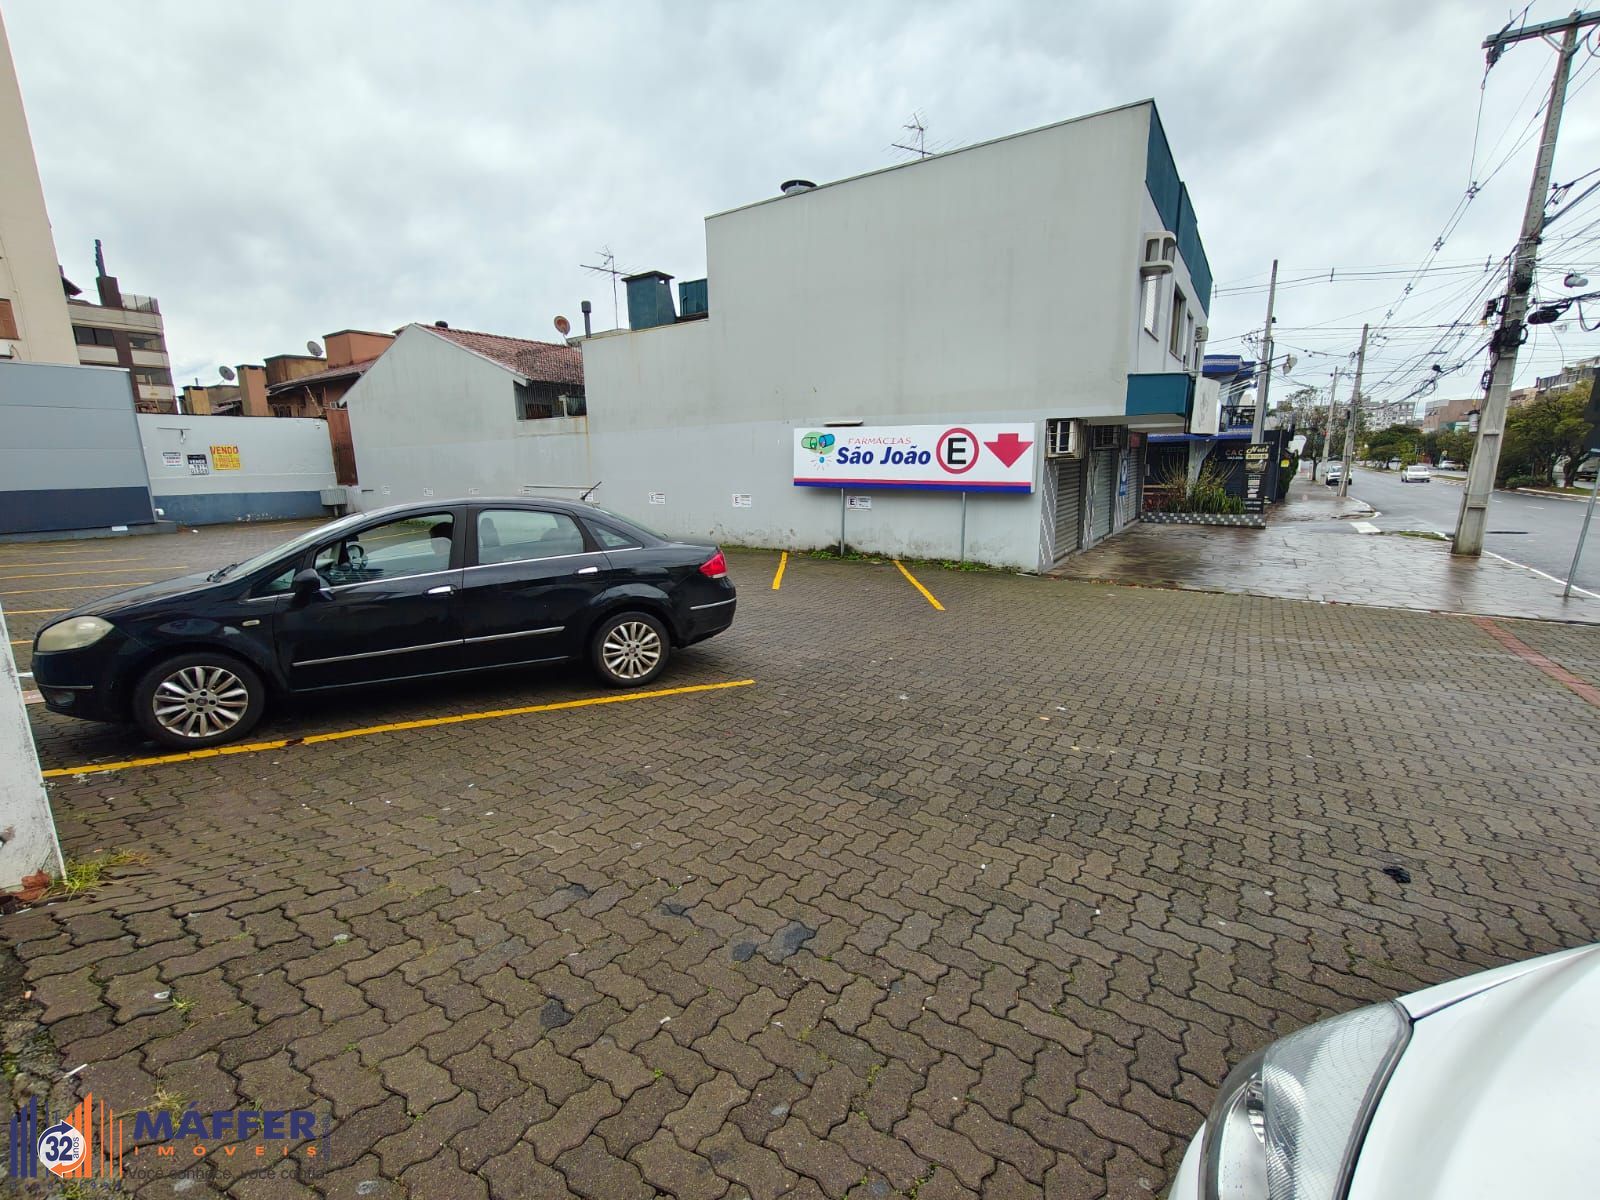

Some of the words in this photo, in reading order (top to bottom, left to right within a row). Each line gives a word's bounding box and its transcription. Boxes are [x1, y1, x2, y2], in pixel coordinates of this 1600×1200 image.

[209, 446, 239, 455] VENDO
[836, 446, 874, 465] São
[880, 445, 931, 465] João
[947, 437, 967, 465] E
[849, 498, 856, 506] E
